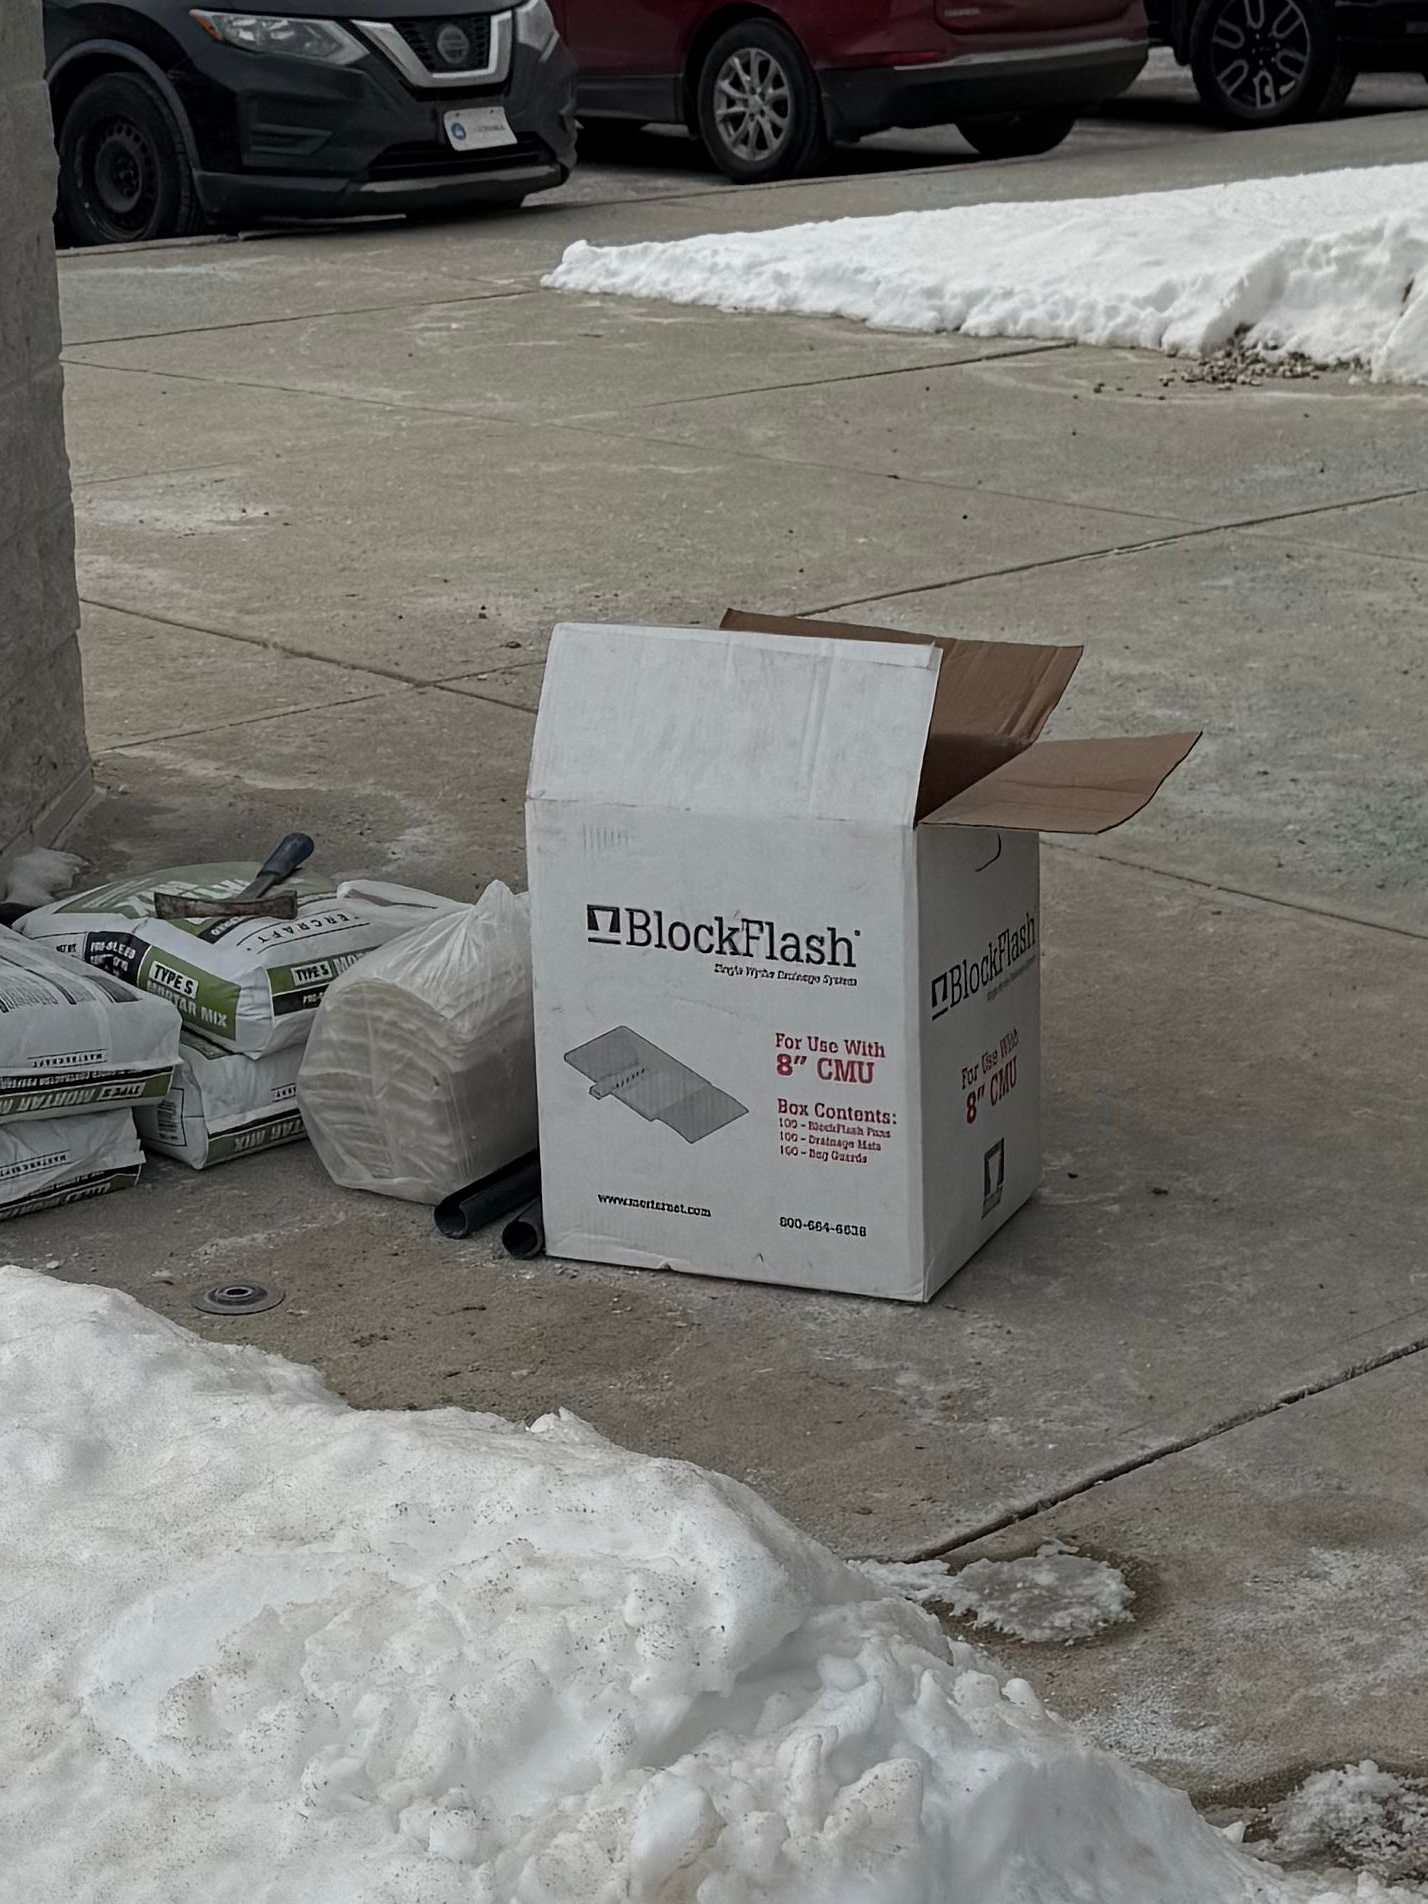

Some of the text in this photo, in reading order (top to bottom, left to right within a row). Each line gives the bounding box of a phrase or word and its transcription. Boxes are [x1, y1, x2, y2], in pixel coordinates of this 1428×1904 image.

[154, 964, 193, 995] TYPE S
[294, 966, 320, 981] TYPE
[201, 1006, 227, 1027] MIX
[775, 1033, 886, 1057] For Use With
[817, 1057, 875, 1084] CMU
[962, 1064, 979, 1089] For
[990, 1056, 1018, 1106] CMU
[17, 1089, 97, 1112] MORTAR
[777, 1098, 897, 1125] Box Contents:
